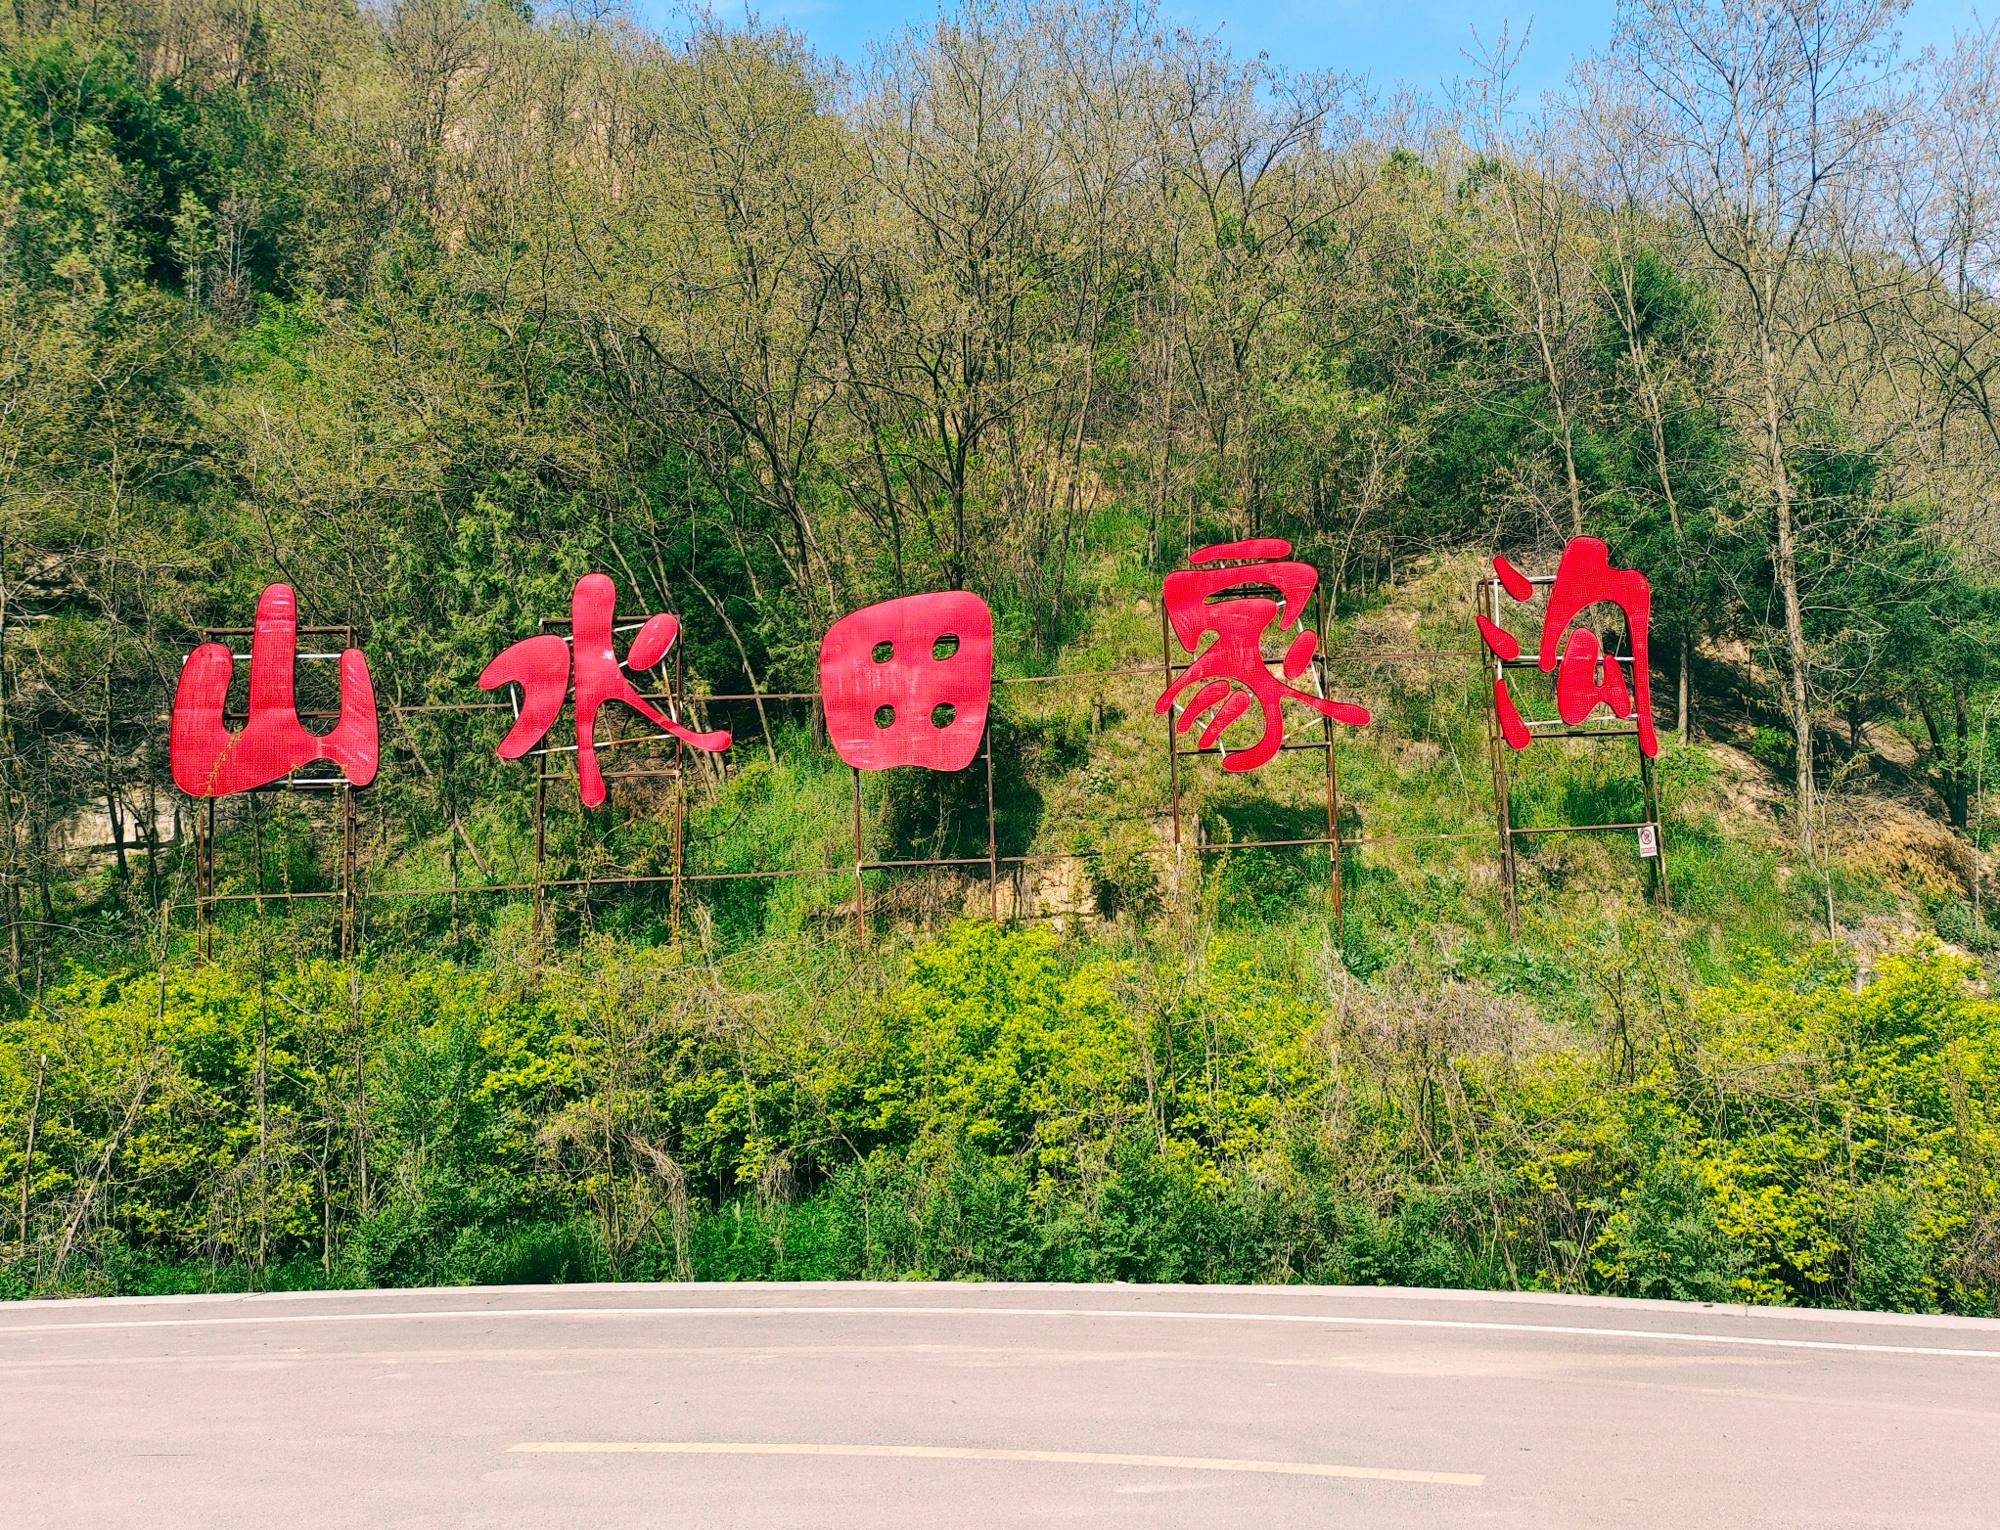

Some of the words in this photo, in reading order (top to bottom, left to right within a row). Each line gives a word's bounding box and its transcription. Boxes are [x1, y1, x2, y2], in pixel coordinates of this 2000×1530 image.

[169, 535, 1658, 808] 山水田家沟
